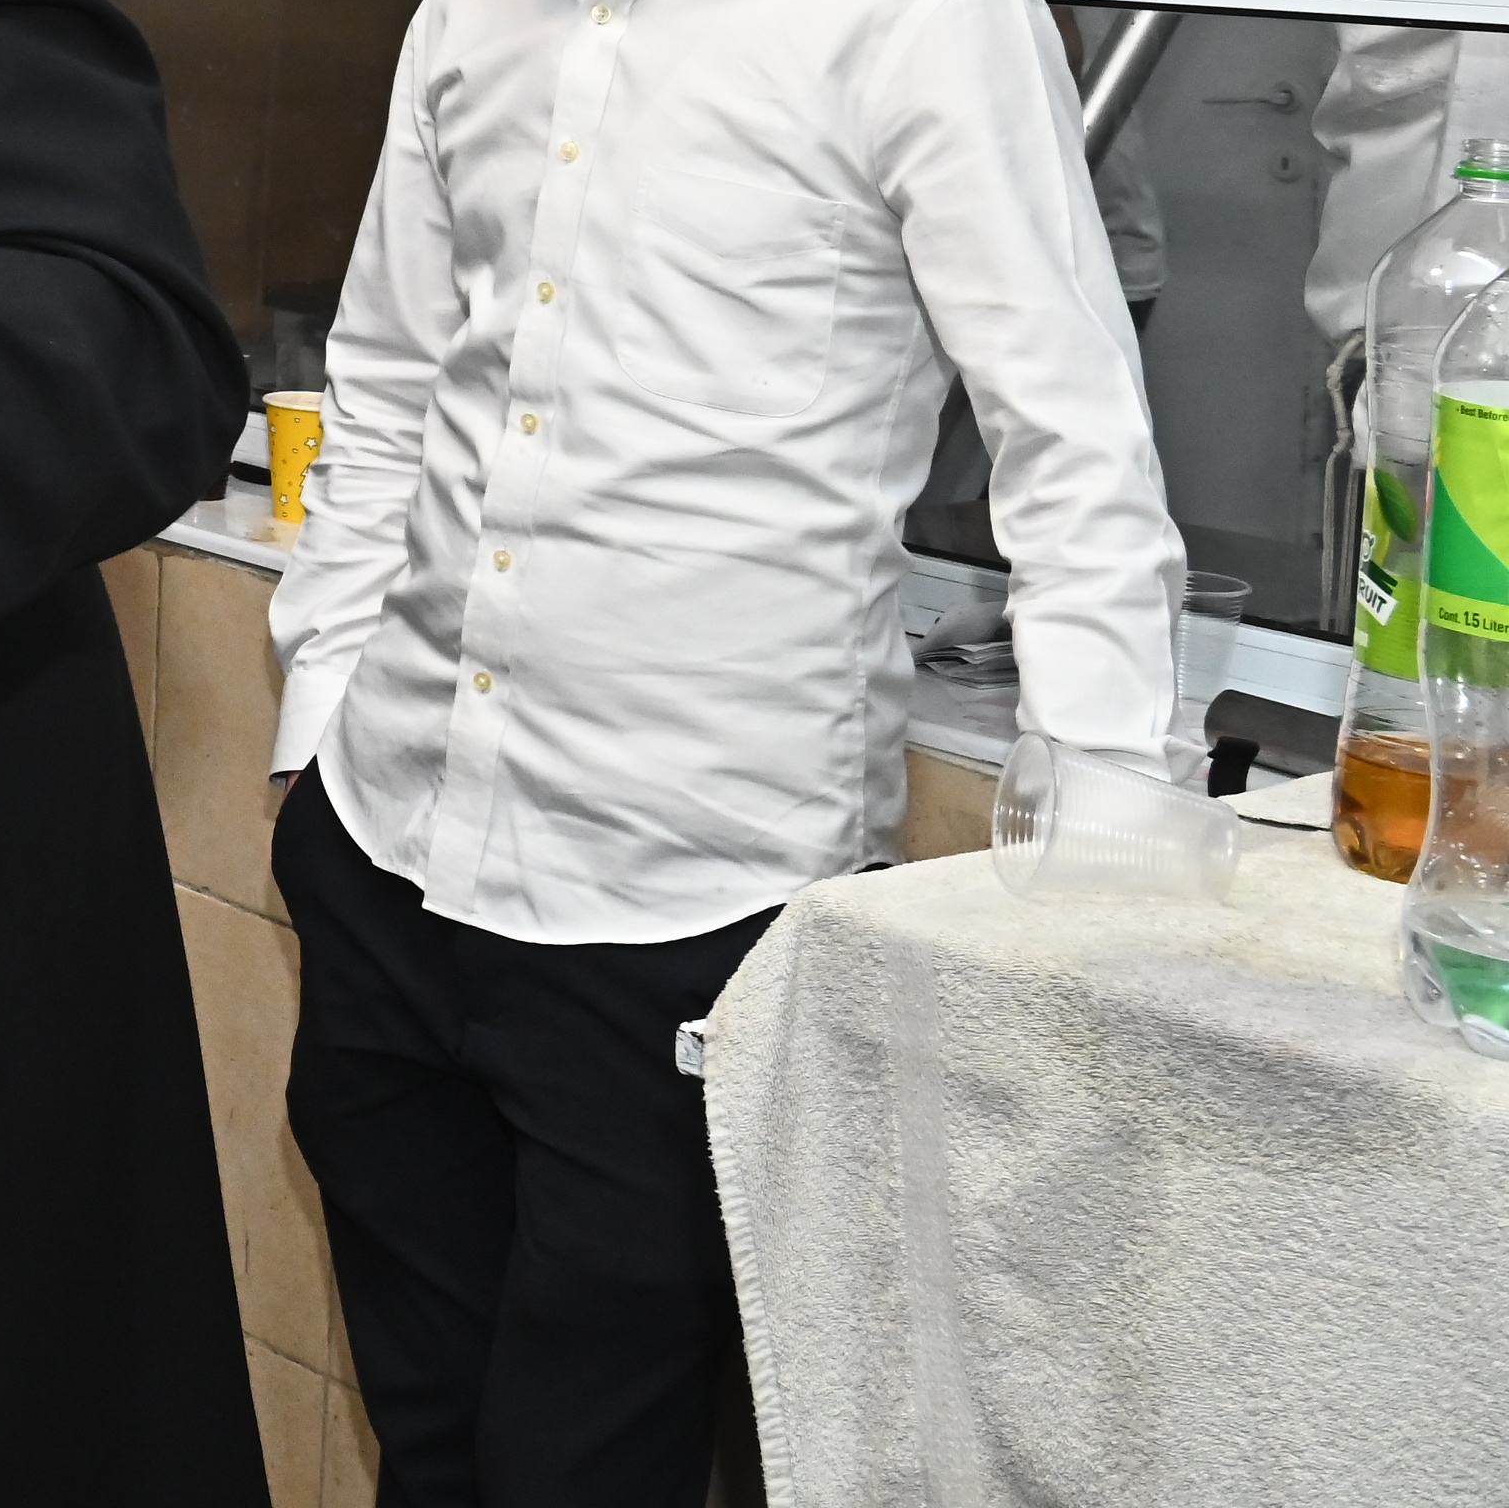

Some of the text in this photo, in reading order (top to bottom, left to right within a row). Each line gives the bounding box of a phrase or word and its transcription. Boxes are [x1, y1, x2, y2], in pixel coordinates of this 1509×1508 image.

[1478, 408, 1509, 422] Before
[1358, 578, 1388, 614] RUIT
[1439, 607, 1461, 624] Cont.
